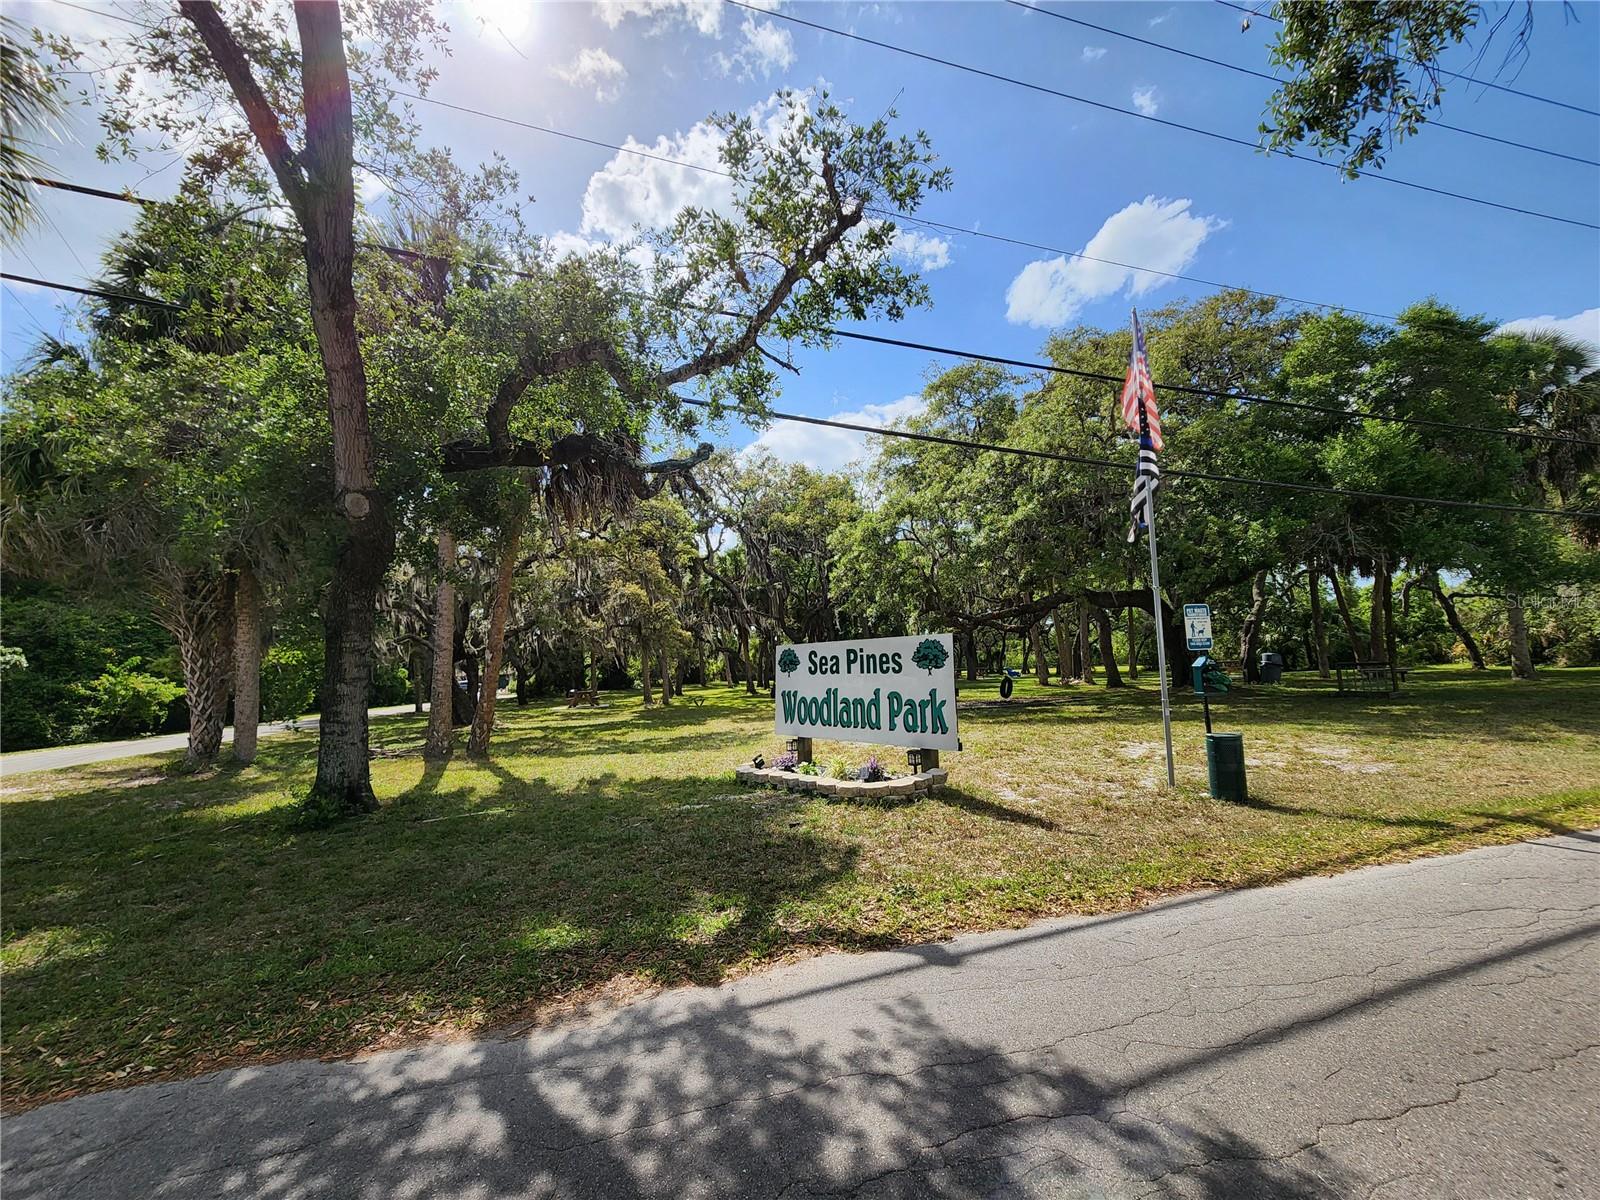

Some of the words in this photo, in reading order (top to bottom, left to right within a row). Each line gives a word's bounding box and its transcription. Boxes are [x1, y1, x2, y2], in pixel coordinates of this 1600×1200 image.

[808, 650, 840, 675] Sea
[847, 648, 903, 675] Pines
[781, 688, 882, 730] Woodland
[887, 688, 949, 735] Park
